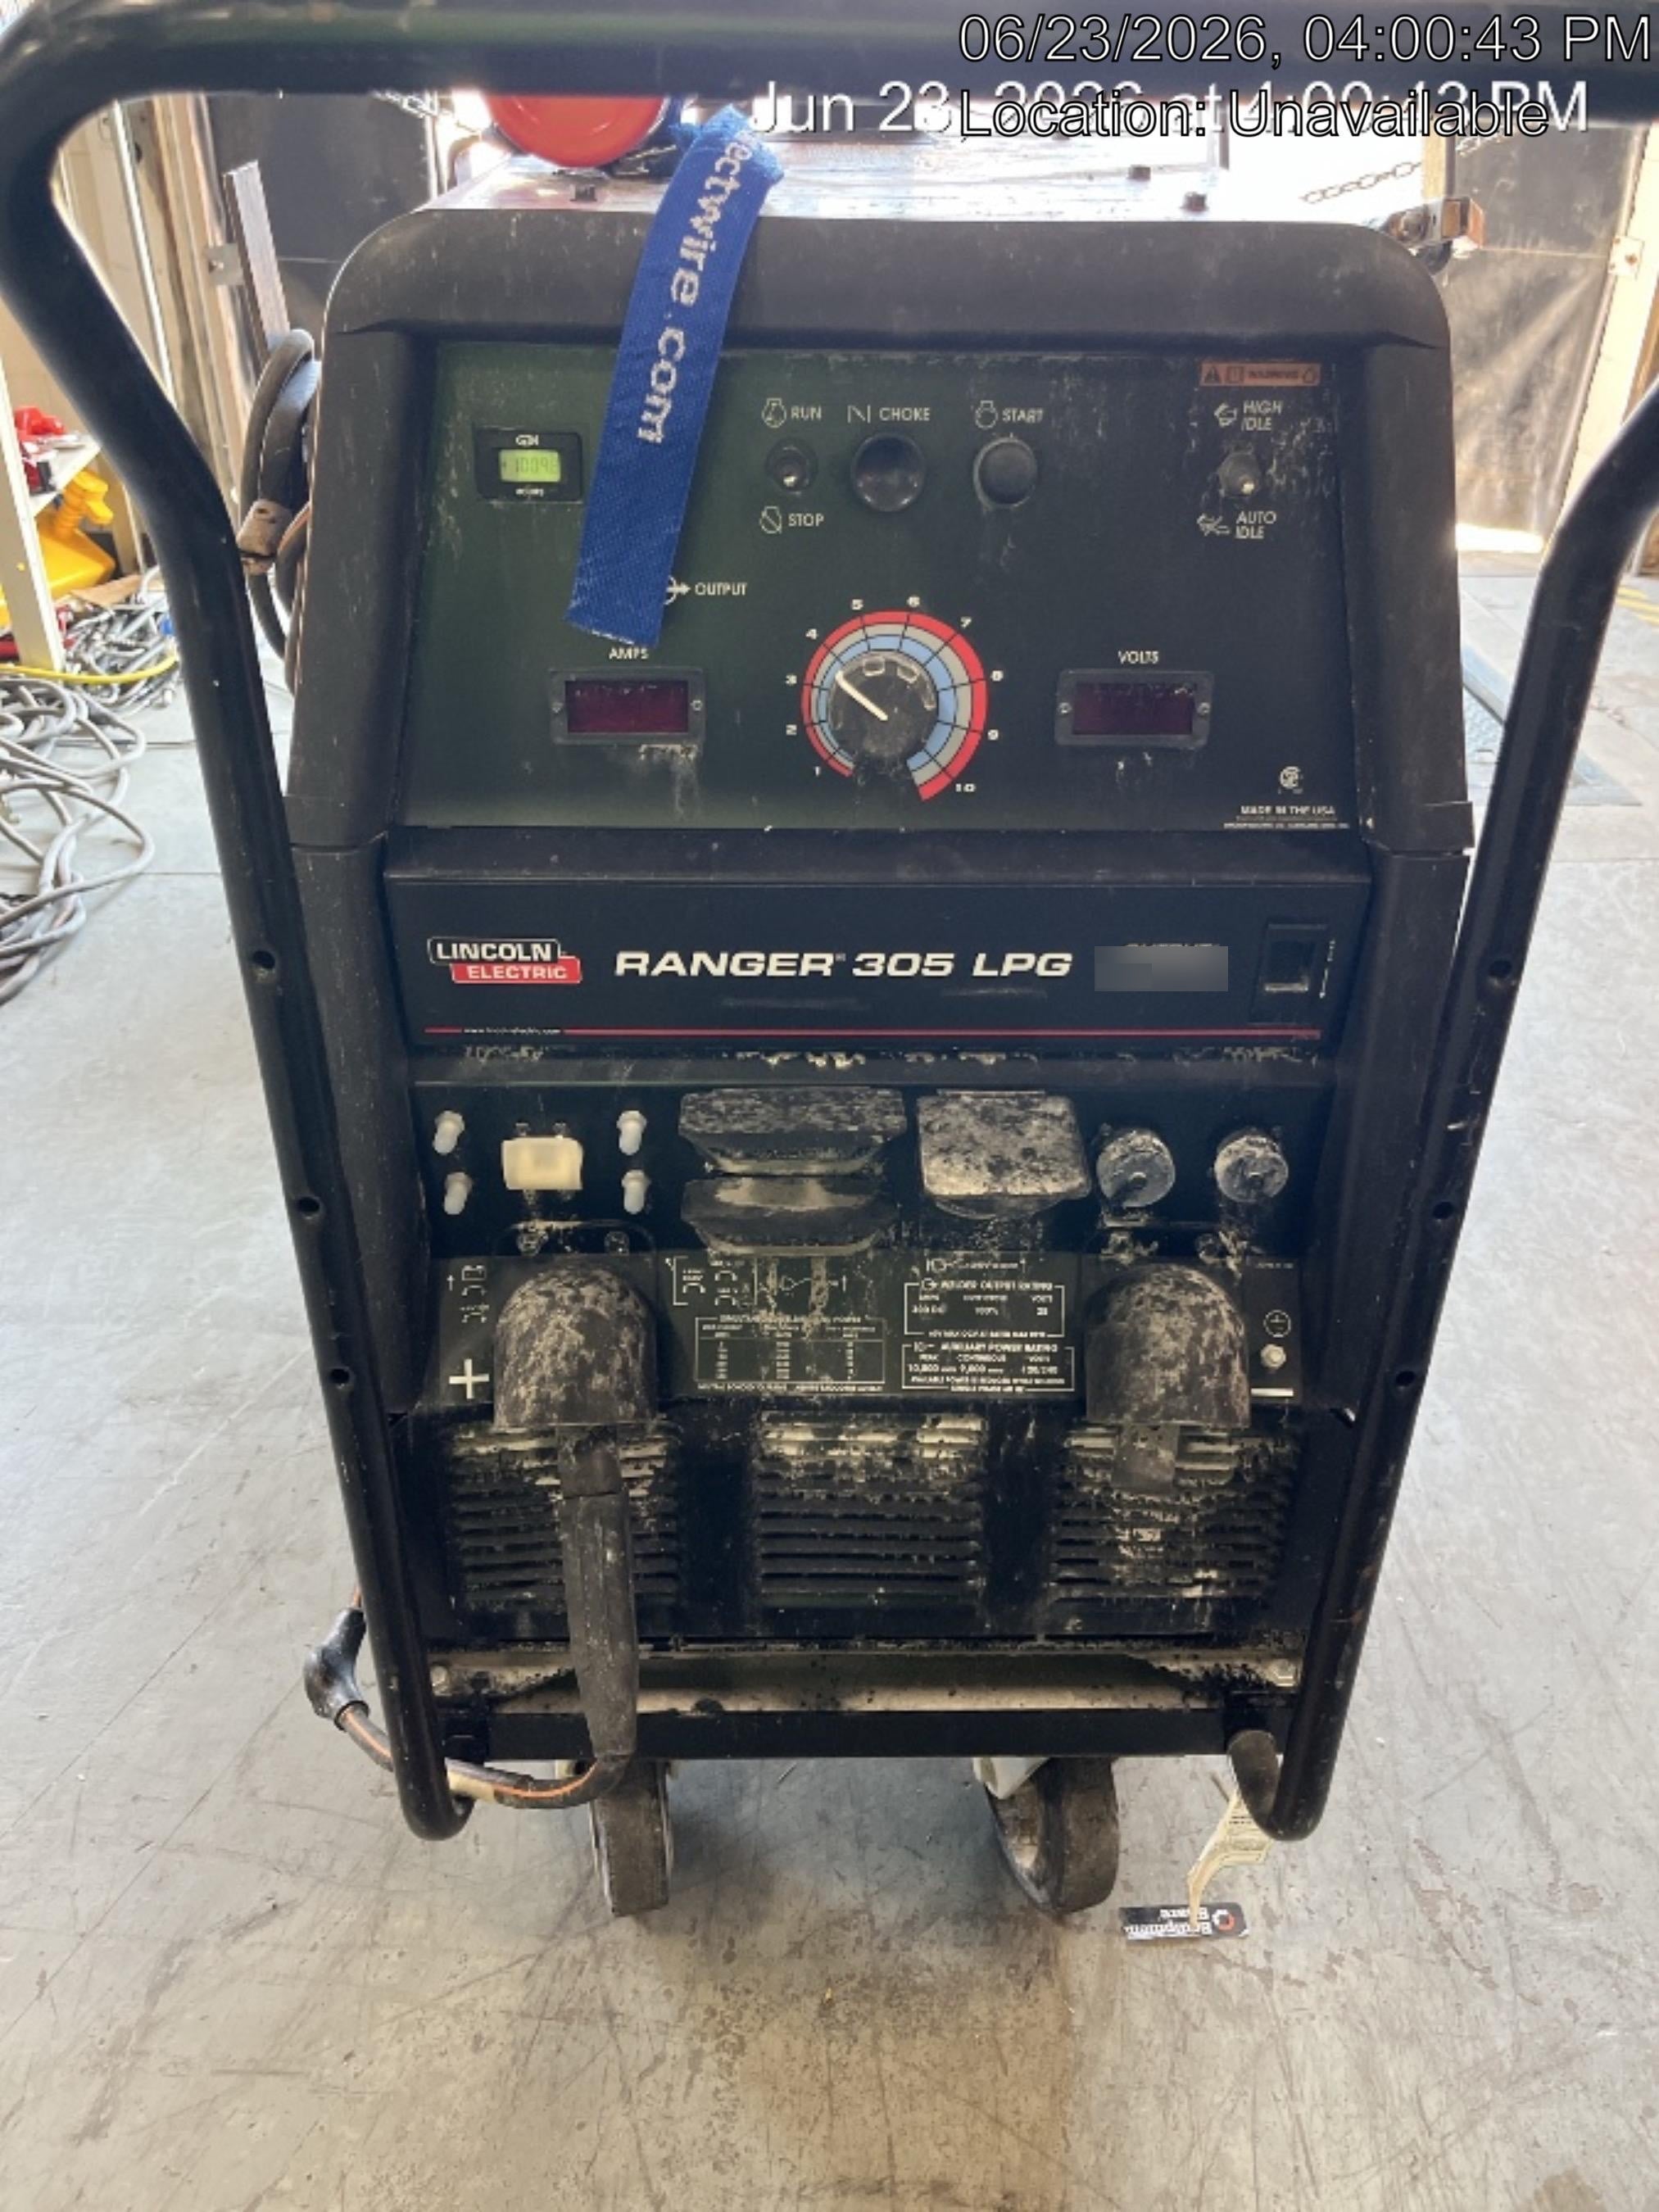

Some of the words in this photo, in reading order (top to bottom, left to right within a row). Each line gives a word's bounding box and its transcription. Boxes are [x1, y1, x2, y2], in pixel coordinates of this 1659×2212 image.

[791, 406, 822, 419] RUN
[879, 407, 931, 422] CHOKE
[1243, 400, 1283, 415] HIGH
[1002, 407, 1045, 423] START
[1241, 417, 1272, 431] IDLE
[788, 514, 824, 527] STOP
[1235, 510, 1277, 524] AUTO
[1235, 526, 1265, 539] IDLE
[695, 582, 747, 596] OUTPUT
[851, 598, 863, 610] 5
[959, 616, 972, 628] 7
[805, 628, 818, 640] 4
[609, 646, 650, 660] AMPS
[1117, 650, 1159, 664] VOLTS
[786, 674, 798, 686] 3
[435, 942, 553, 962] LINCOLN
[851, 952, 955, 977] 305
[972, 952, 1073, 977] LPG
[466, 964, 568, 980] ELECTRIC
